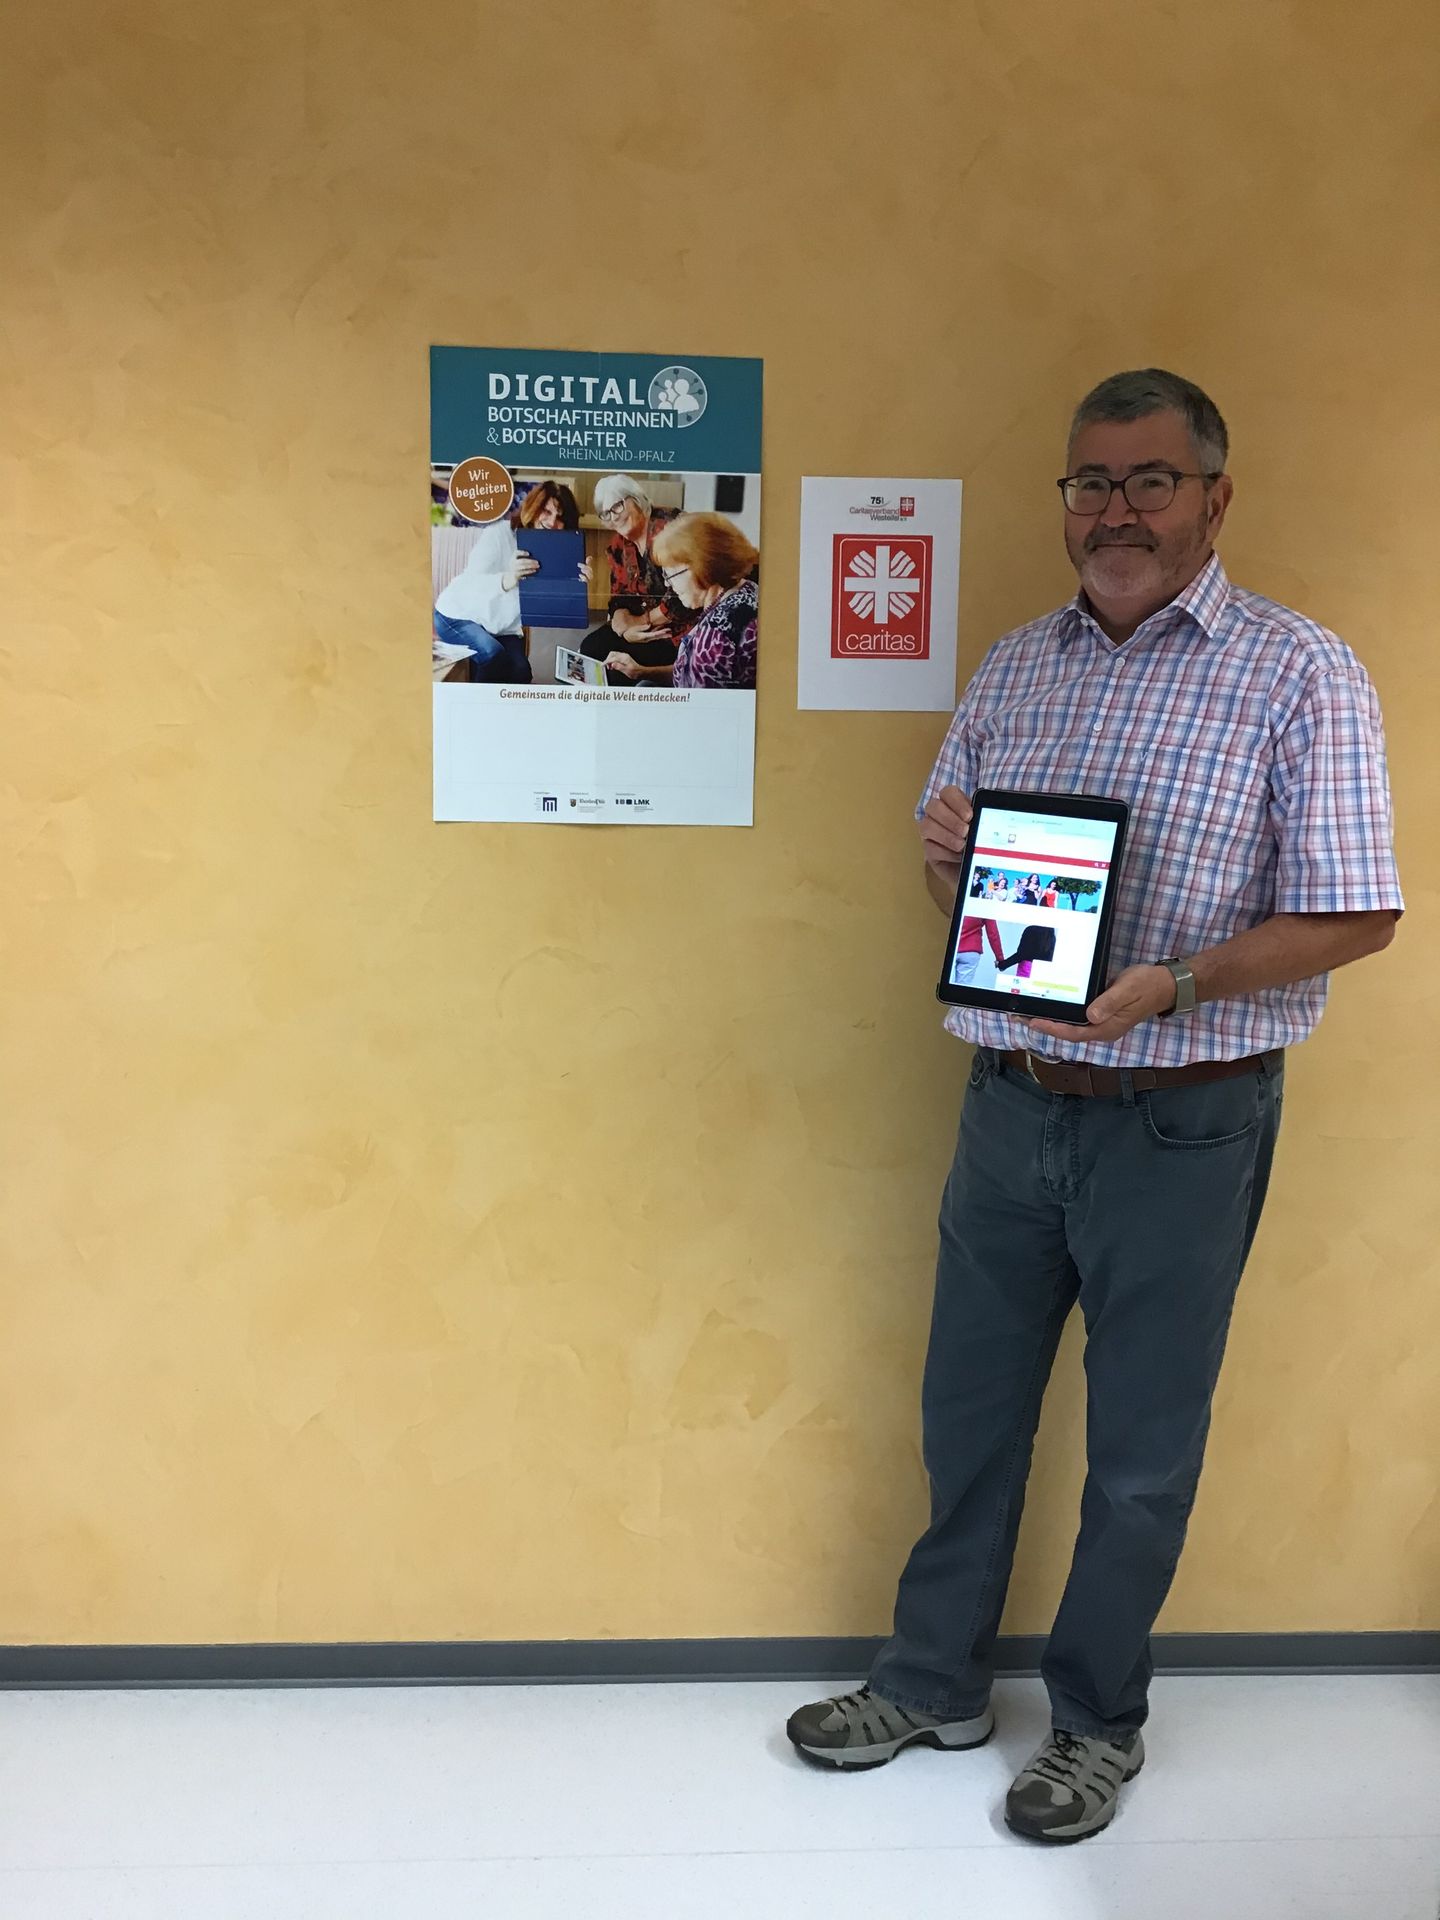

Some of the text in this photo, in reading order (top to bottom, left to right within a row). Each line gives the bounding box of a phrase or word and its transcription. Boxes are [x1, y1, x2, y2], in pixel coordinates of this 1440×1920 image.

[488, 373, 645, 405] DIGITAL
[487, 406, 674, 428] BOTSCHAFTERINNEN
[558, 447, 675, 463] RHEINLAND-PFALZ
[468, 469, 490, 481] Wir
[455, 483, 508, 499] begleiten
[473, 498, 494, 512] Sie!
[845, 629, 916, 651] caritas
[499, 688, 691, 703] Gemeinsam die digitale Welt entdecken!
